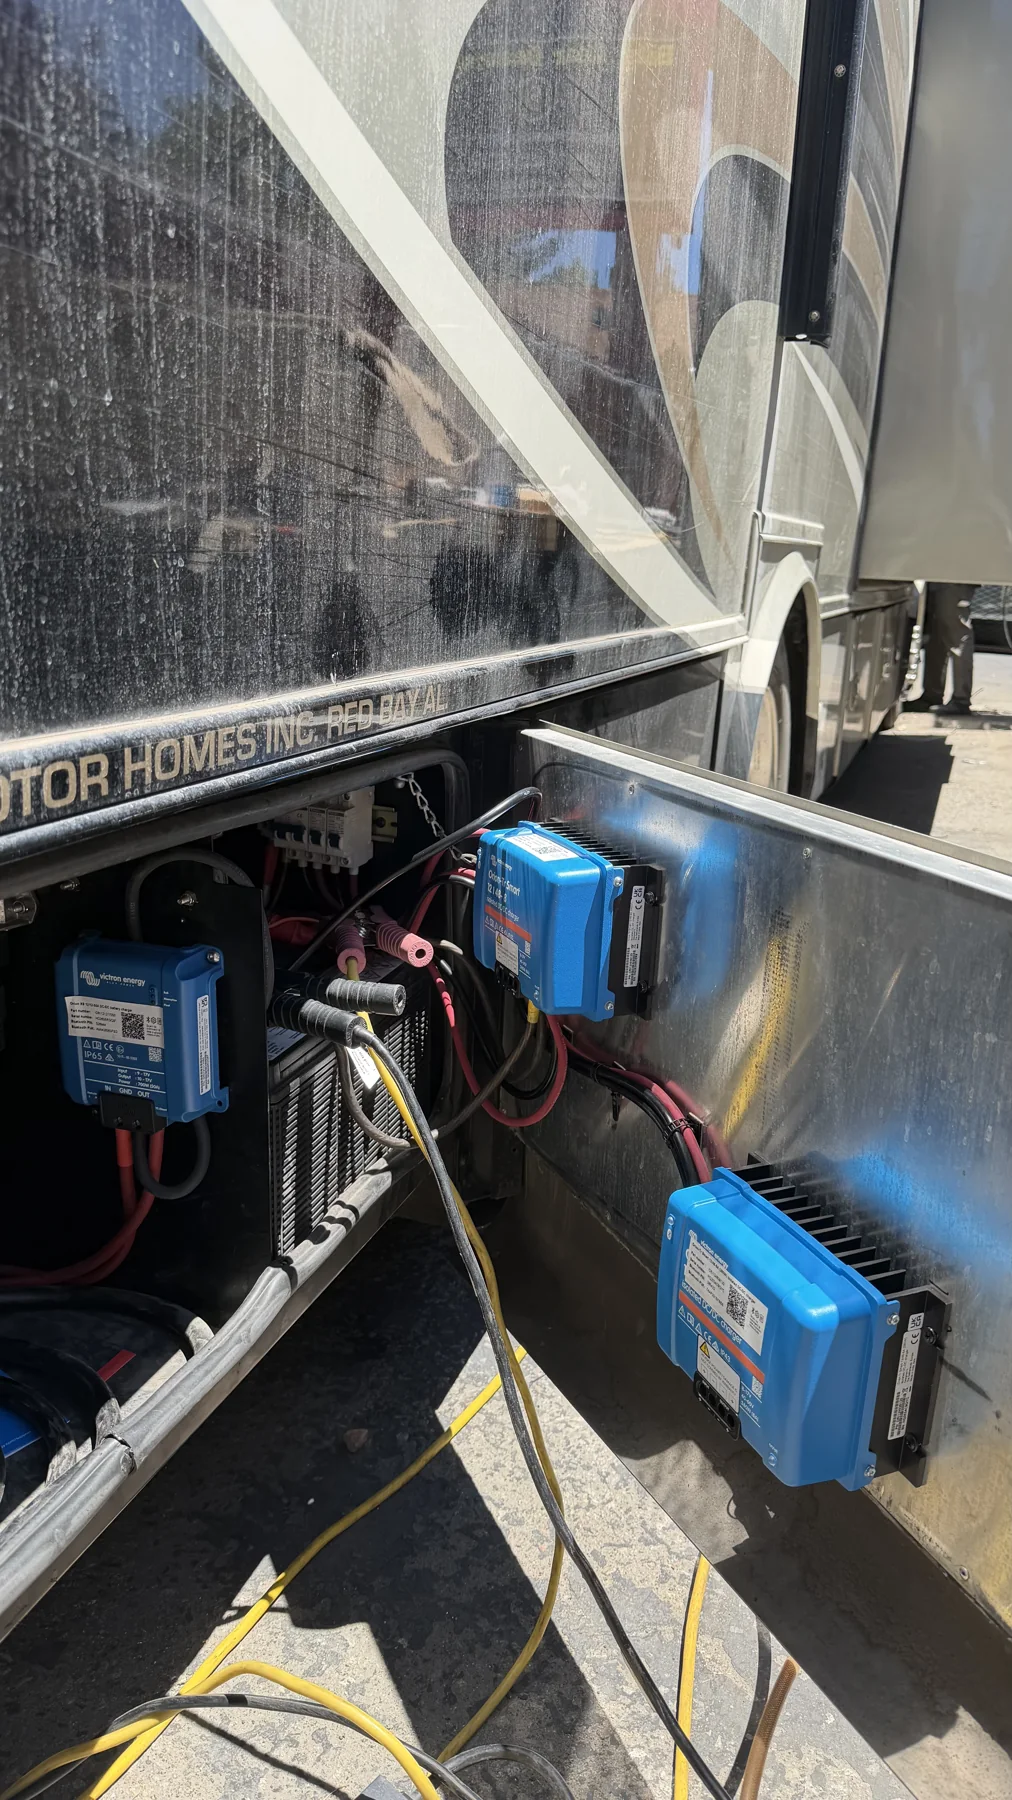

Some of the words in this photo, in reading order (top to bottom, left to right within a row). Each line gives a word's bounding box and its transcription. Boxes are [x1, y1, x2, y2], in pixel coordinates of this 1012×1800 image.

[0, 754, 109, 821] TOR
[124, 723, 257, 790] HOMES
[327, 699, 374, 740] RED
[379, 688, 420, 727] BAY
[424, 684, 447, 715] AL
[505, 879, 521, 897] Smart
[100, 972, 122, 983] victron
[123, 976, 146, 988] energy
[104, 1043, 114, 1052] CE
[84, 1051, 103, 1060] IP65
[118, 1087, 133, 1095] GND
[137, 1090, 151, 1098] OUT
[911, 1316, 917, 1329] UK
[720, 1319, 743, 1345] charger
[910, 1332, 919, 1345] CE
